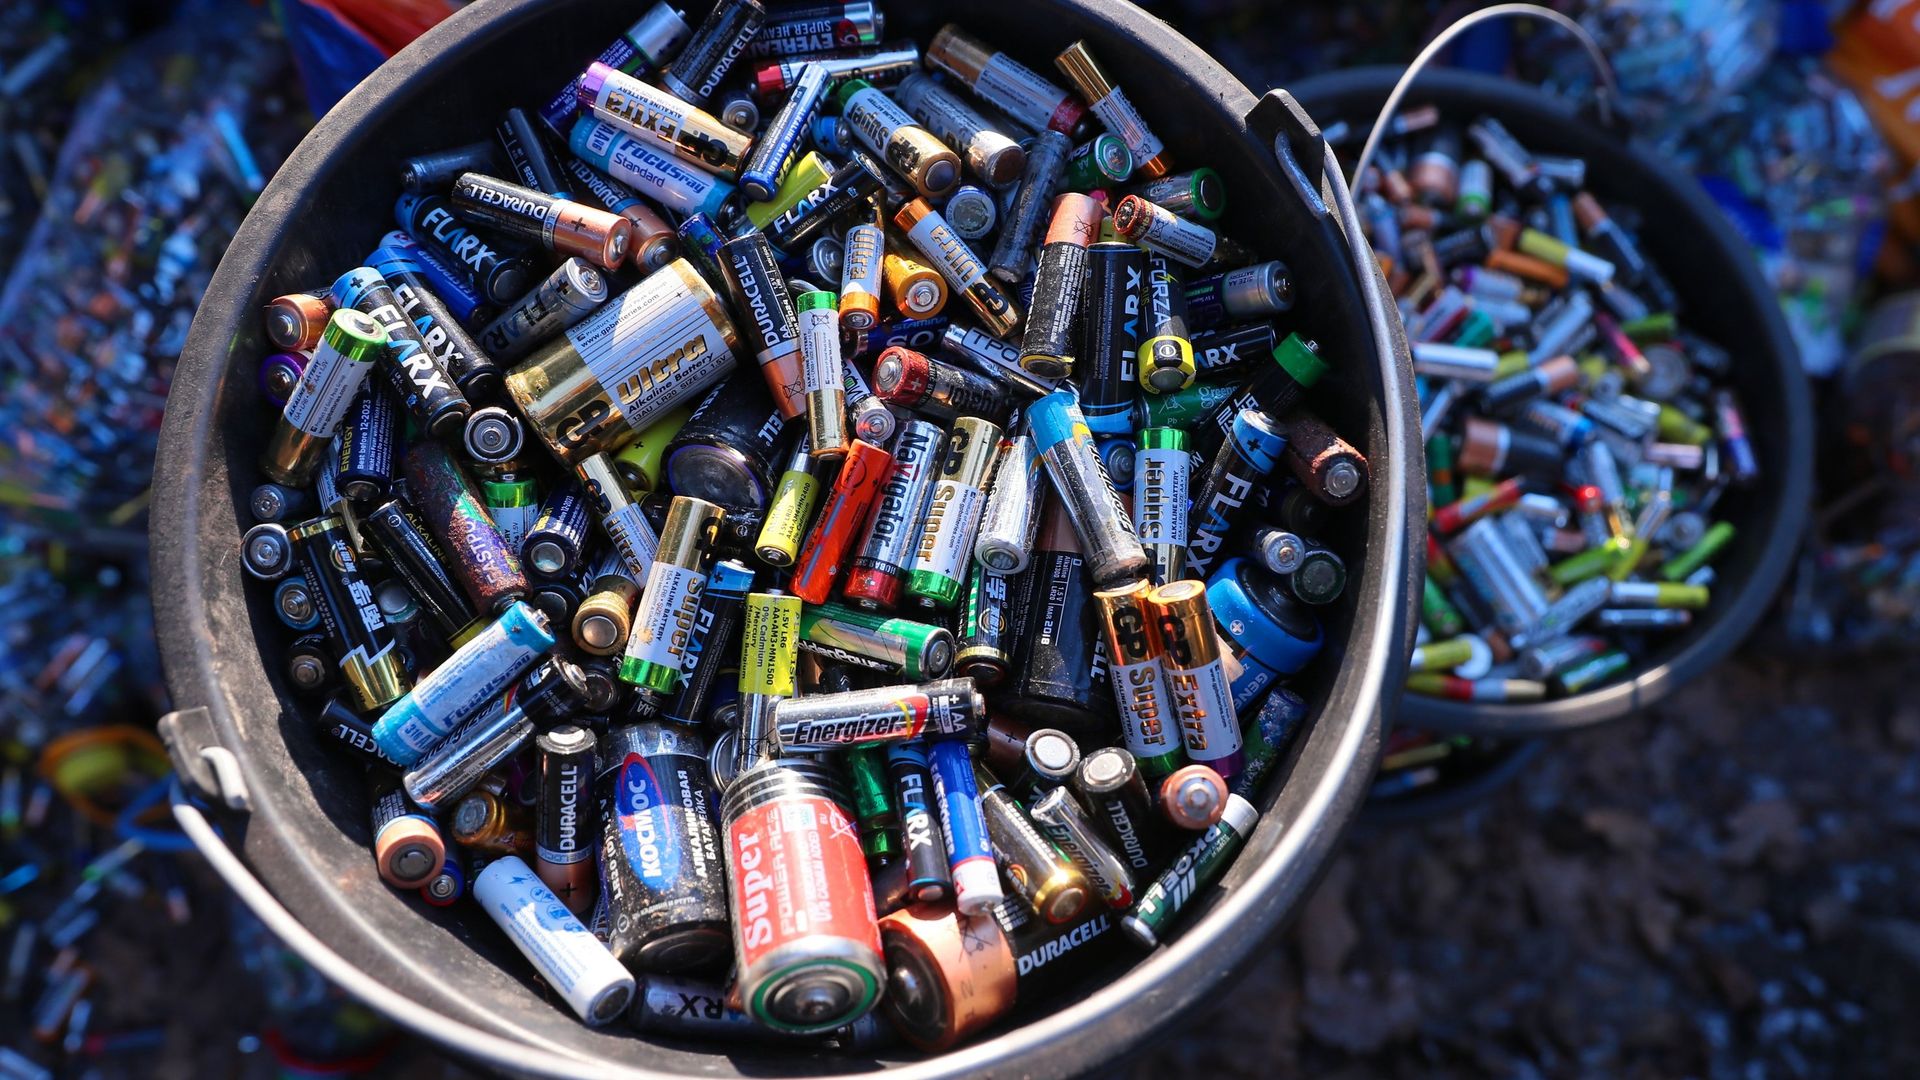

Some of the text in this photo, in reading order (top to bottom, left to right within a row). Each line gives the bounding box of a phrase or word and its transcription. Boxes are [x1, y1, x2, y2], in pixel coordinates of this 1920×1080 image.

[752, 32, 834, 55] EVEREA
[796, 20, 832, 36] SUPER
[699, 24, 759, 98] DURACELL
[618, 86, 683, 119] ALKALINE BATTERY
[614, 152, 665, 188] Standard
[764, 106, 808, 176] ALKALINE BATTERY
[469, 182, 550, 222] DURACELL
[522, 165, 538, 187] 2025
[570, 158, 621, 208] DURACELL
[772, 174, 840, 235] FLARX
[422, 207, 497, 273] FLARX
[580, 293, 661, 349] www.gpbatteries.com
[732, 254, 781, 347] DURACELL
[892, 316, 948, 330] STAMINA
[1121, 265, 1142, 382] FLARX
[1151, 258, 1172, 328] FORZA
[367, 304, 451, 399] FLARX
[778, 323, 791, 339] AA
[1194, 343, 1241, 371] ARX
[285, 358, 322, 417] ALKALINE BATTERY
[627, 352, 714, 414] Alkaline Battery
[632, 407, 654, 423] 13AU
[656, 388, 678, 411] LR20
[679, 375, 700, 391] SIZE
[709, 354, 728, 370] 1.5V
[336, 424, 358, 473] ENERGY
[355, 397, 375, 470] Best before 12-2023
[555, 400, 611, 446] GP
[874, 432, 930, 548] Navigator
[947, 487, 969, 549] www.gpbatteries.com
[1139, 457, 1170, 540] Super
[1171, 470, 1180, 540] ALKALINE BATTERY
[405, 511, 448, 564] ALKALINE
[918, 485, 955, 563] Super
[1184, 471, 1254, 577] FLARX
[1048, 584, 1057, 601] LR20
[1052, 553, 1064, 578] MN1300
[1059, 555, 1071, 579] Alkaline
[658, 571, 682, 641] ALKALINE BATTERY
[667, 576, 706, 661] Super
[749, 605, 760, 648] /Mercury
[756, 605, 769, 667] 0% Cadmium
[779, 607, 790, 648] 1.5V LR6
[1039, 619, 1053, 645] 2018
[678, 607, 716, 690] FLARX
[793, 713, 903, 745] Energizer
[953, 713, 968, 733] AA
[1128, 666, 1167, 747] Super
[1171, 673, 1209, 752] Extra
[559, 765, 579, 850] DURACELL
[627, 777, 663, 880] КОСМОС
[678, 768, 708, 879] АЛКАЛИНОВАЯ
[695, 789, 717, 862] БАТАРЕЙКА
[900, 773, 933, 851] FLARX
[1107, 800, 1148, 869] DURACELL
[740, 832, 774, 951] Super
[771, 853, 797, 936] POWER
[1018, 915, 1111, 977] DURACELL
